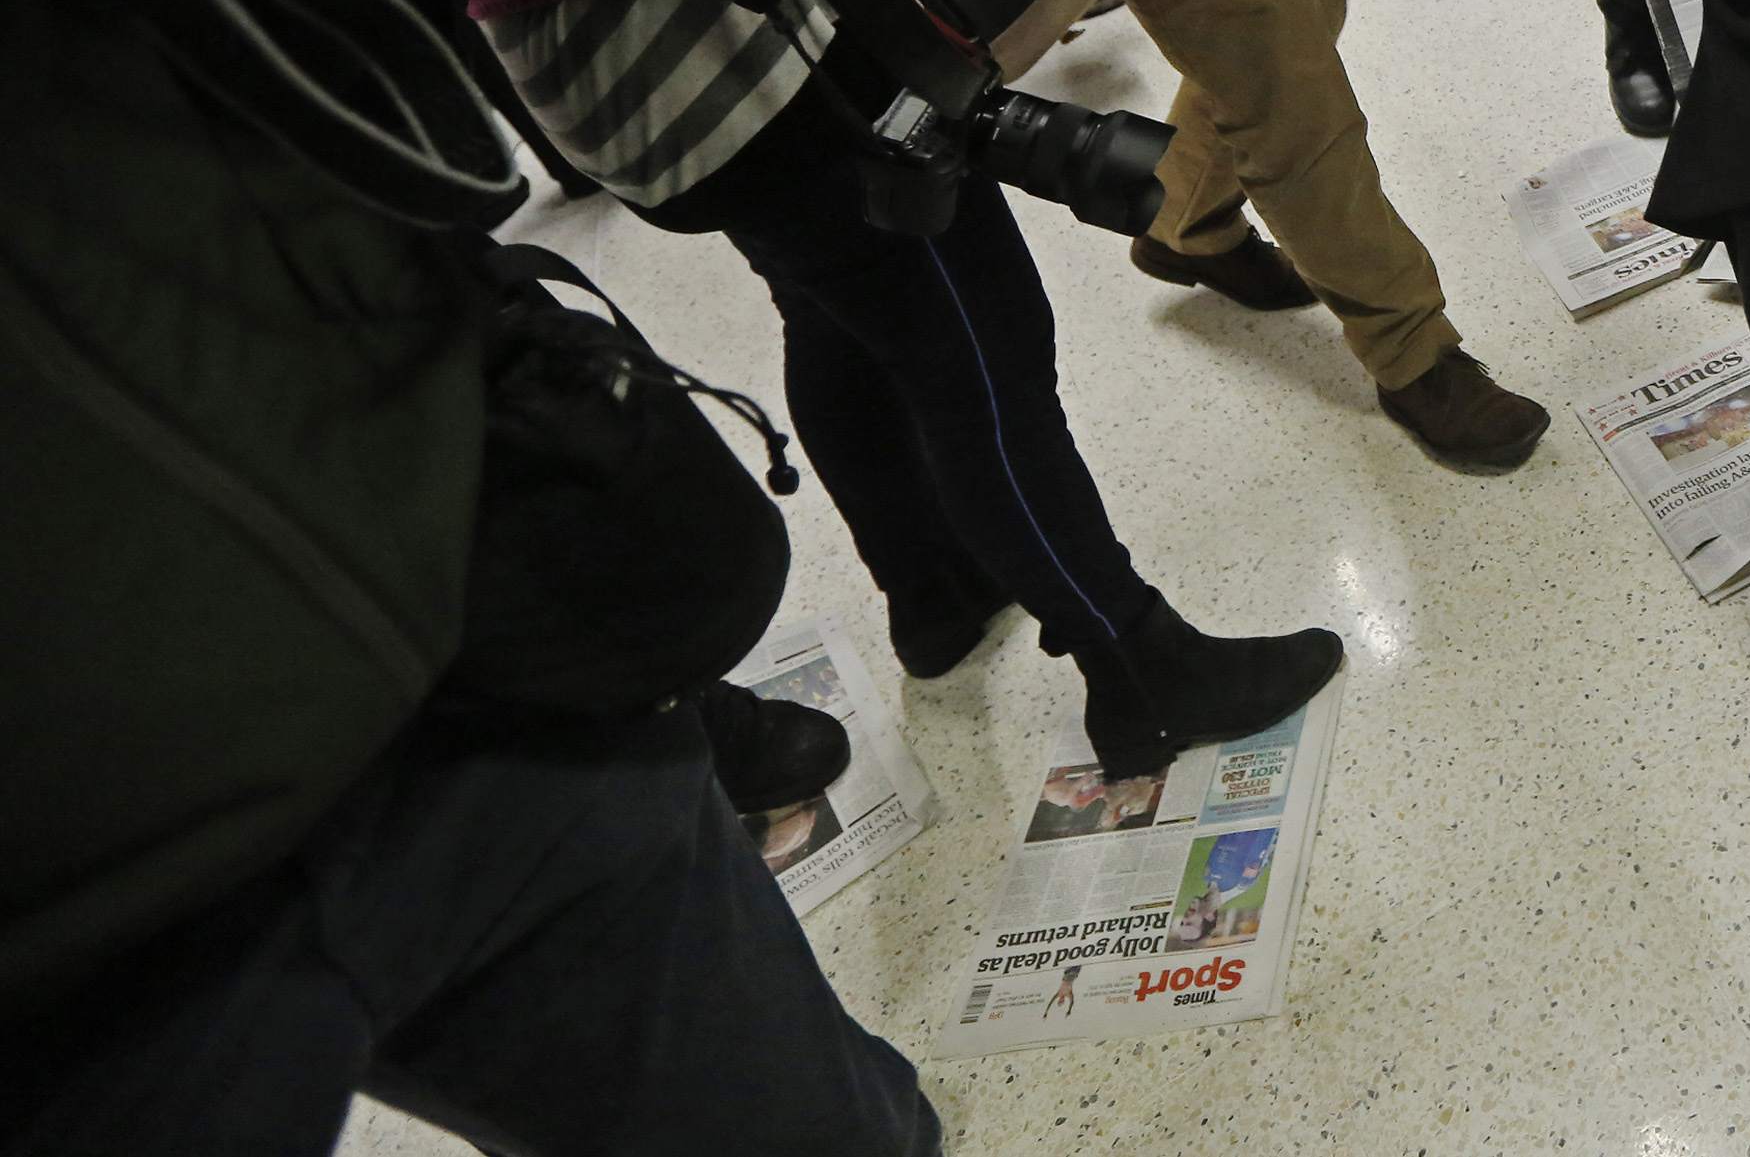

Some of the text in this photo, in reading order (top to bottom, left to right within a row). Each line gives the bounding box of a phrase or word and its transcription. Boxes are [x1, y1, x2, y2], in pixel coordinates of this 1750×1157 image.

[1614, 242, 1692, 279] imes
[1631, 349, 1744, 406] Times
[1648, 460, 1735, 511] Investigation
[1655, 495, 1684, 521] into
[1684, 472, 1730, 506] failing
[1248, 765, 1283, 778] MOT
[996, 910, 1169, 948] Richard returns
[977, 935, 1163, 973] Jolly good deal as
[1136, 956, 1247, 1002] Sport
[1173, 988, 1217, 1007] Times
